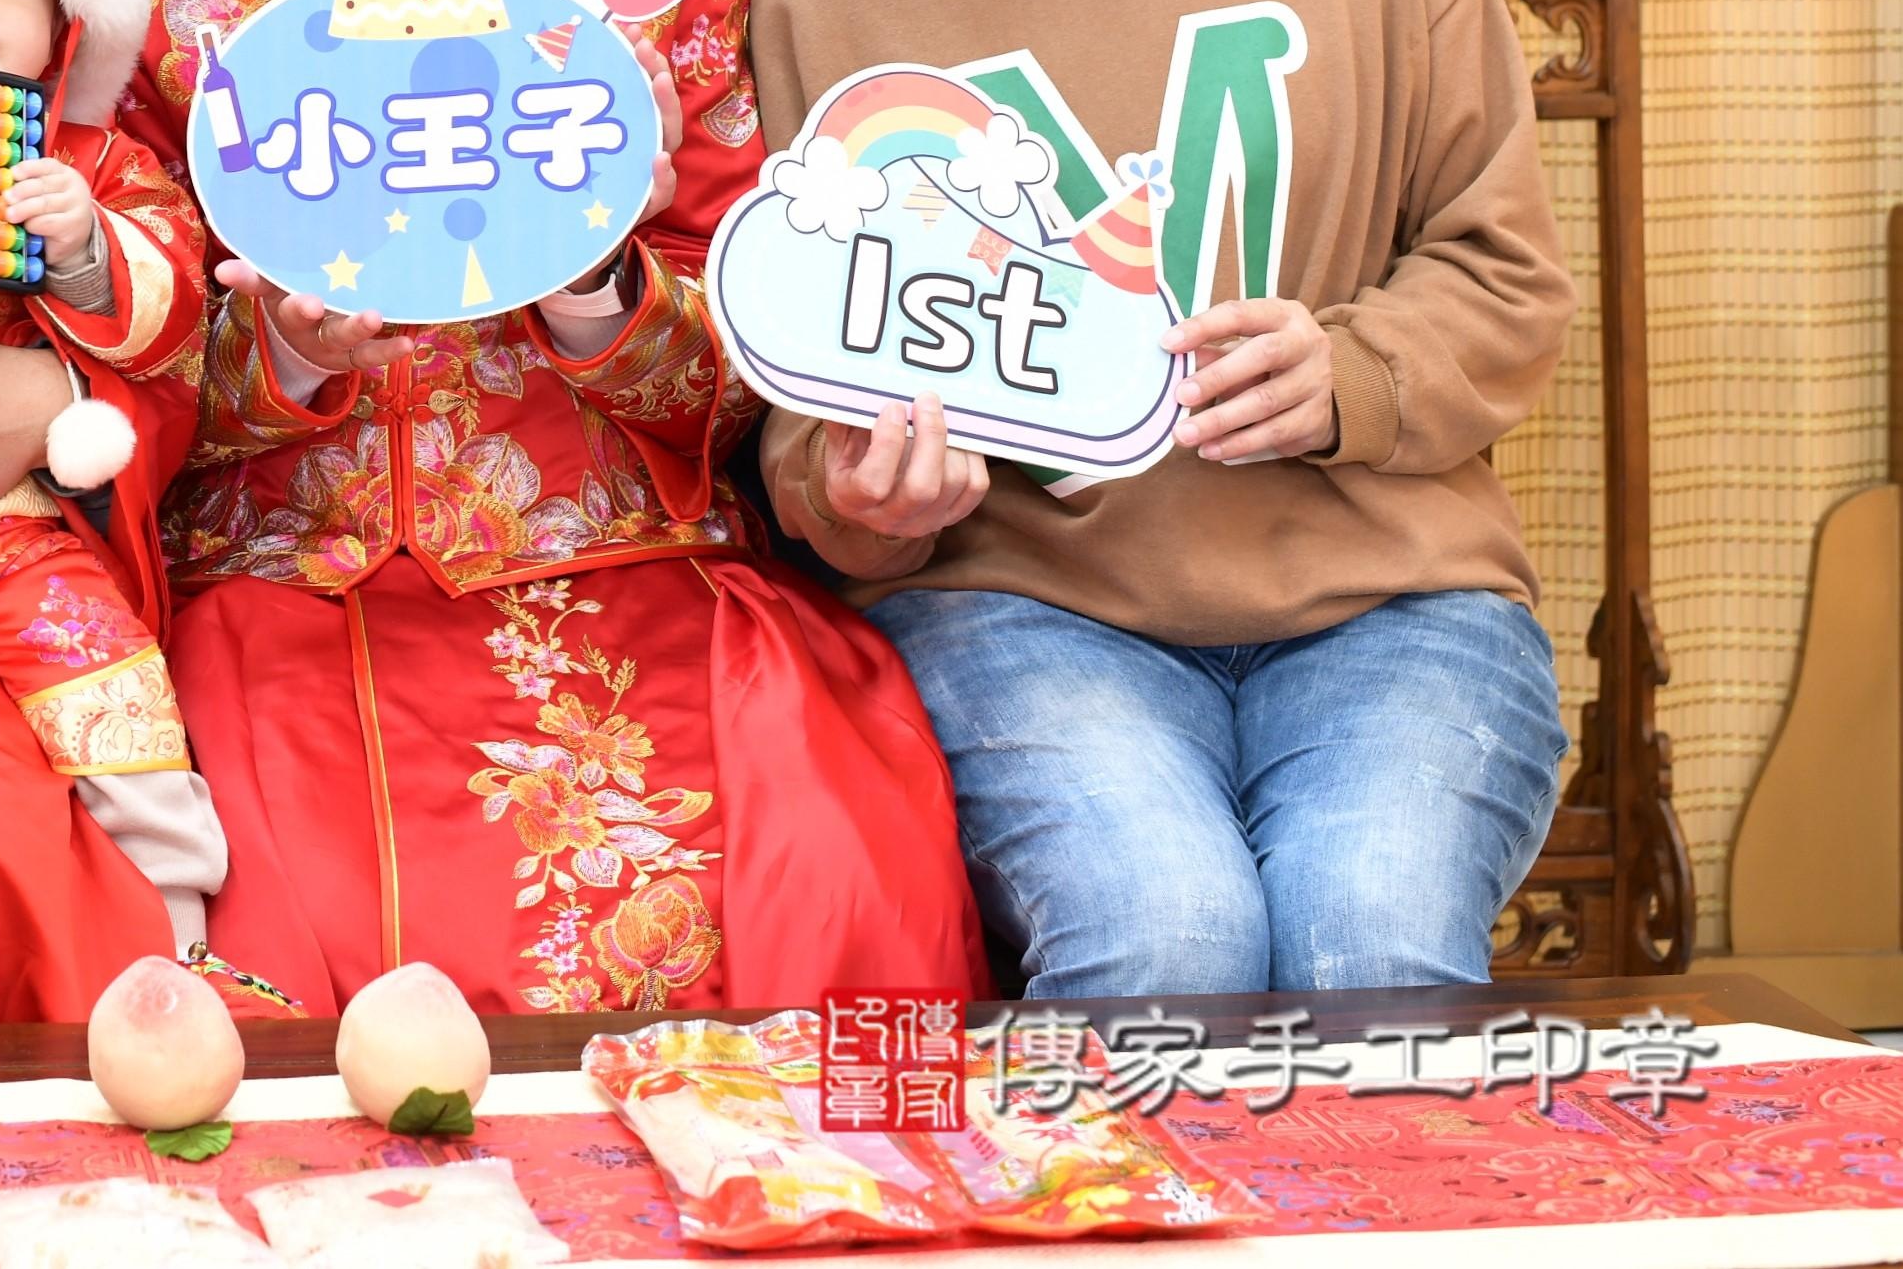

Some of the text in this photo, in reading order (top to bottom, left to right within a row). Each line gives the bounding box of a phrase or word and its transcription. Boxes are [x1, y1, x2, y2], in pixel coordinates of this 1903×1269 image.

[251, 78, 627, 201] 小王子
[841, 233, 1066, 394] 1st
